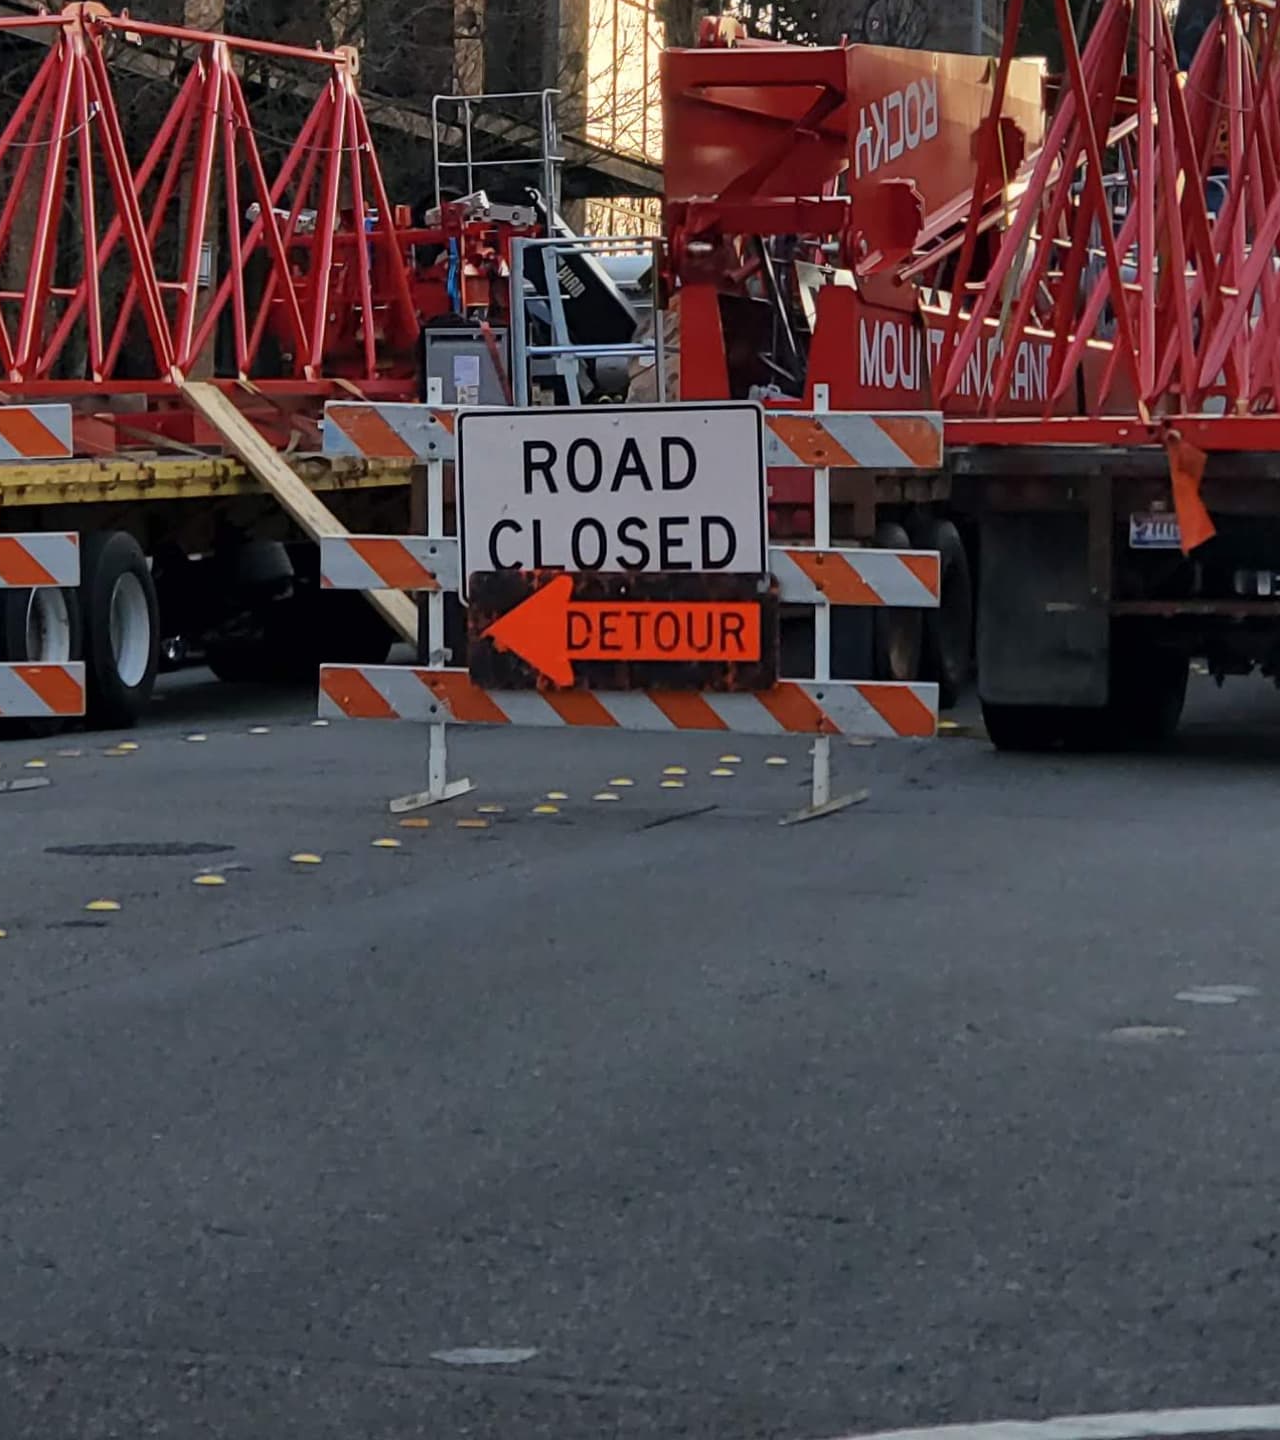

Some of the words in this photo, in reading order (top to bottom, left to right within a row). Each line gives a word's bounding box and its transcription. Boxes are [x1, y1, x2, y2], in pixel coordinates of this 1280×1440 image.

[855, 74, 938, 179] ROCKY
[522, 437, 697, 494] ROAD
[488, 516, 737, 570] CLOSED
[566, 610, 746, 653] DETOUR
